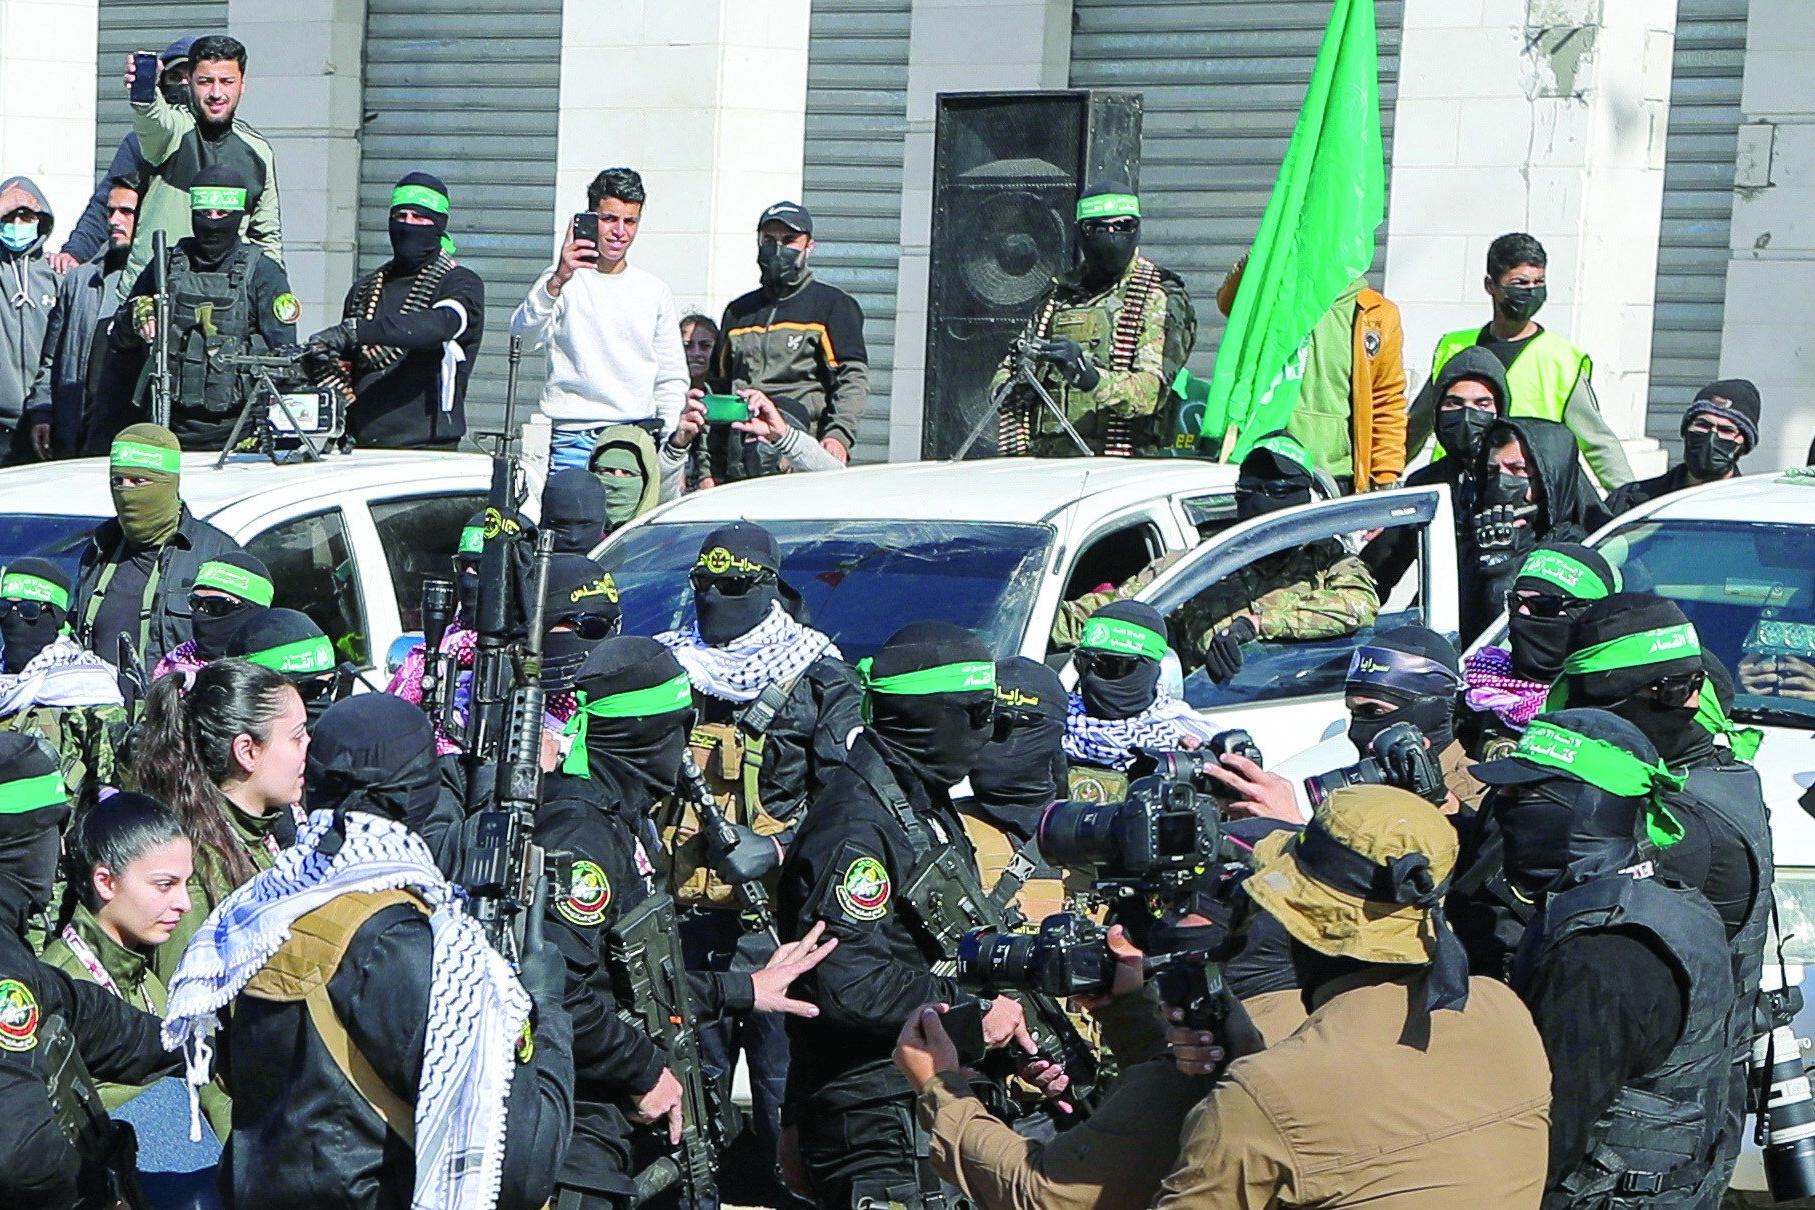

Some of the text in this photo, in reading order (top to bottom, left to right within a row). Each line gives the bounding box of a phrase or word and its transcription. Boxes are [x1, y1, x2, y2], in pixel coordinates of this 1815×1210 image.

[731, 556, 762, 572] سرايا
[1541, 568, 1579, 587] كتائب
[1648, 633, 1687, 653] القسام
[280, 656, 314, 671] القسام
[1360, 657, 1391, 673] سرايا
[997, 686, 1040, 706] سرايا
[1529, 743, 1577, 764] كتائب
